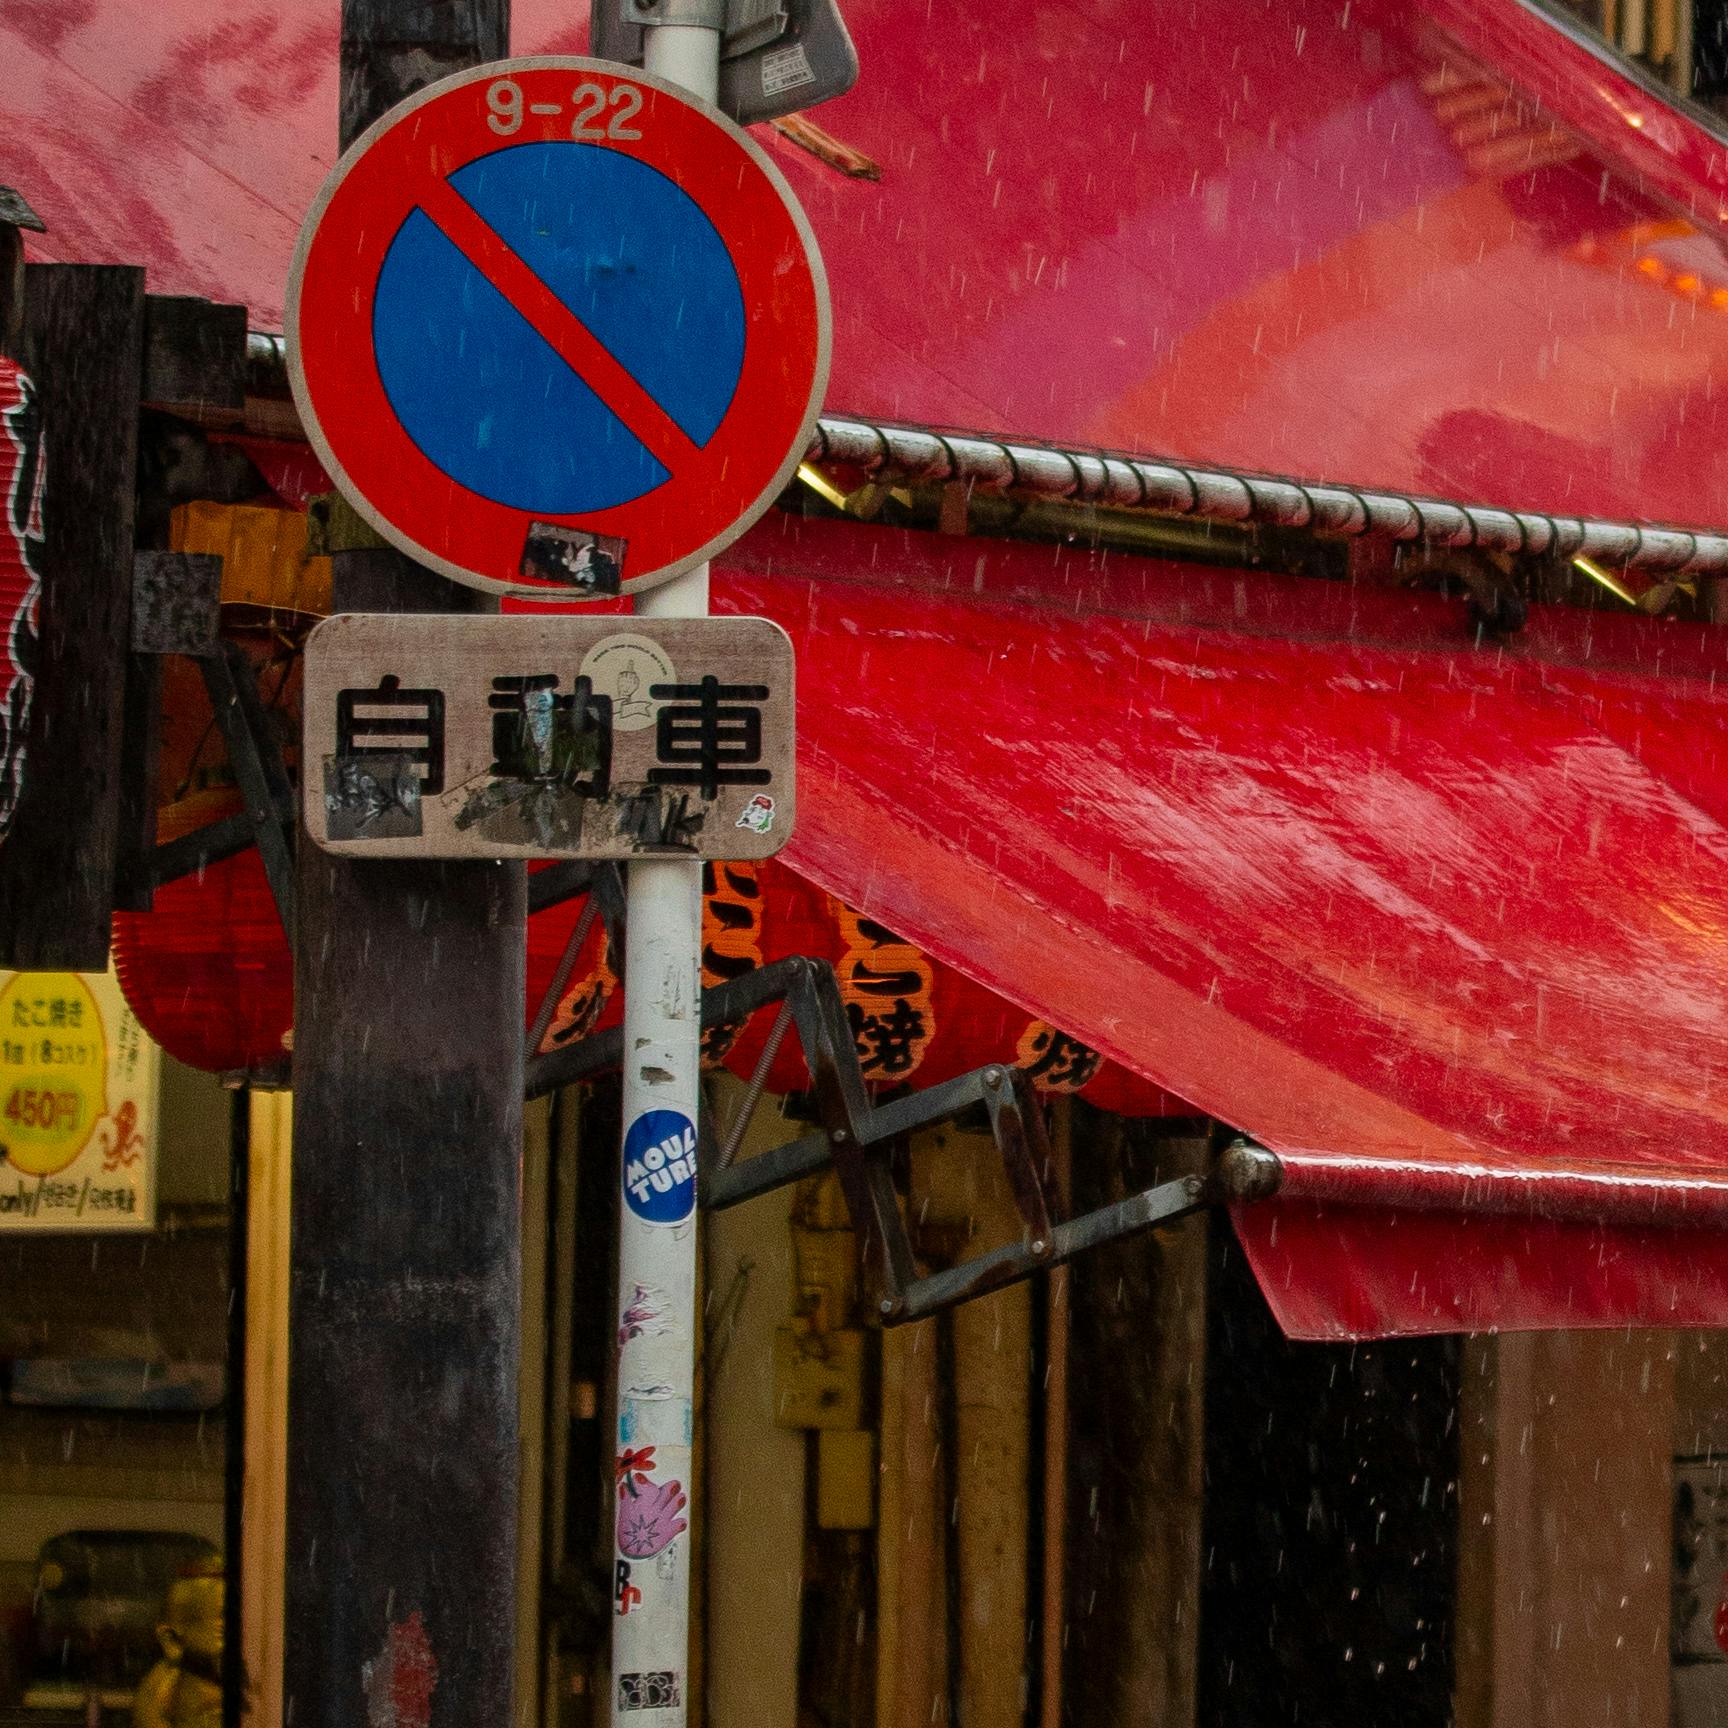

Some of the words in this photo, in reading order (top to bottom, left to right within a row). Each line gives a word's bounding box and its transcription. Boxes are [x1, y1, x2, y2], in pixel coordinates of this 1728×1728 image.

[487, 80, 643, 141] 9-22
[336, 674, 772, 801] 自動車
